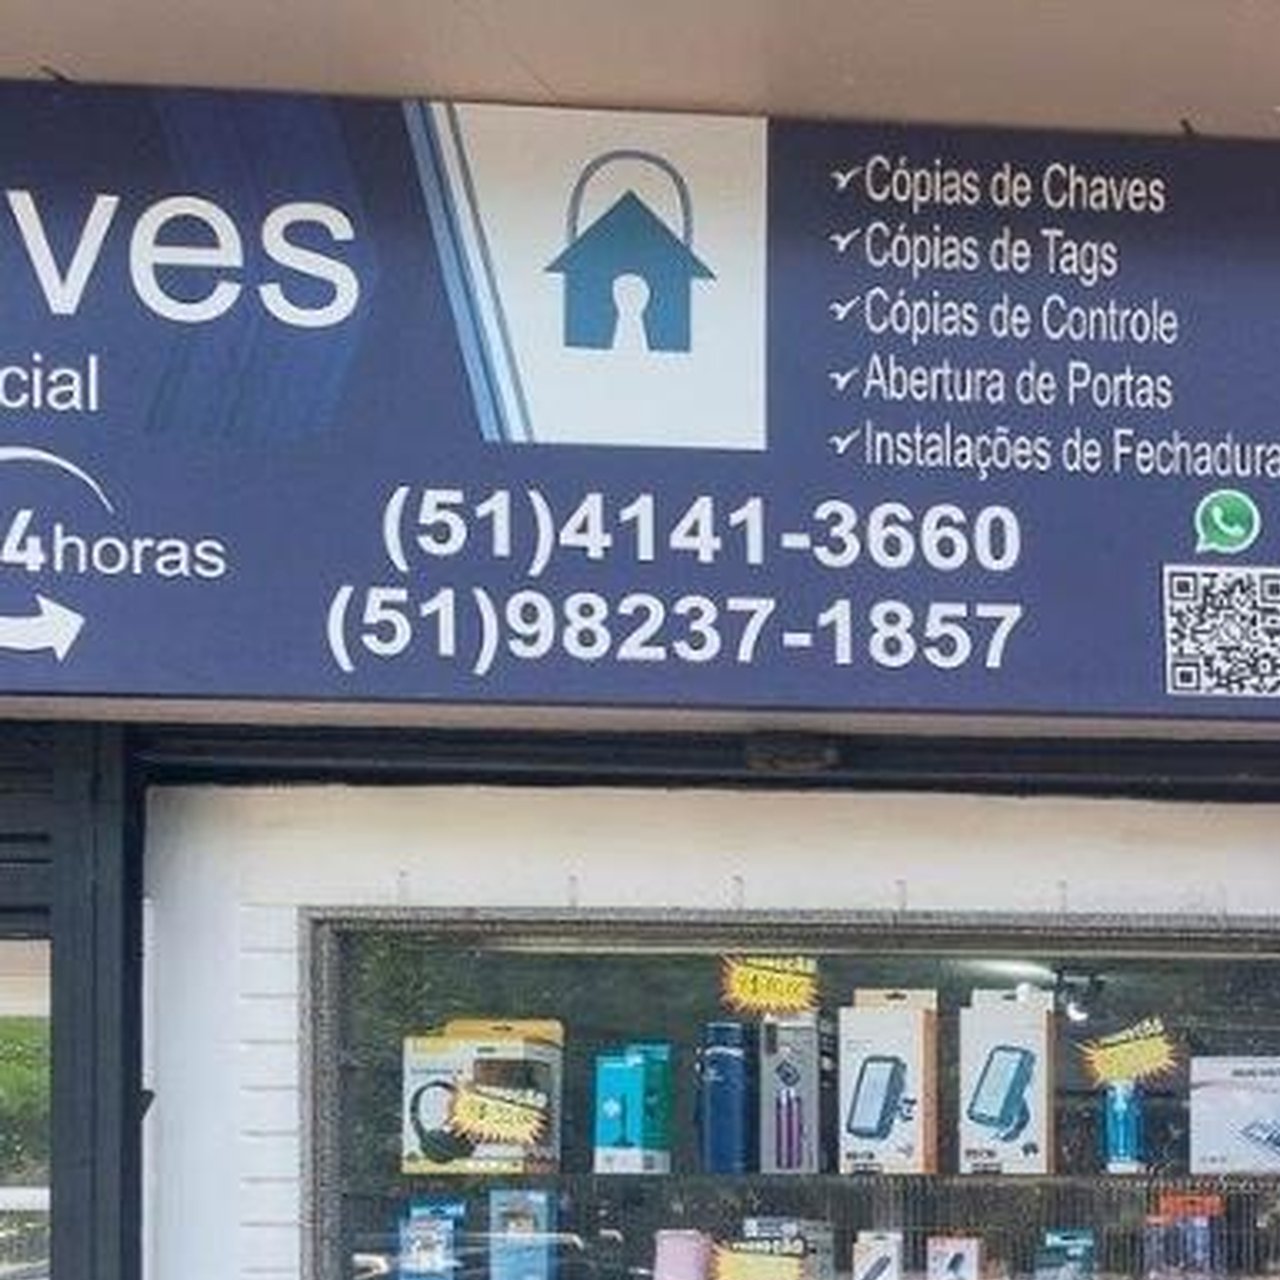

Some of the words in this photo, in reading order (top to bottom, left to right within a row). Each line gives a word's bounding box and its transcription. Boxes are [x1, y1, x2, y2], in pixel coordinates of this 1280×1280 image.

[865, 154, 981, 215] Cópias
[990, 162, 1032, 208] de
[1042, 162, 1166, 213] Chaves
[7, 190, 360, 328] ves
[865, 221, 981, 281] Cópias
[989, 227, 1032, 274] de
[1040, 228, 1118, 288] Tags
[864, 286, 980, 346] Cópias
[989, 293, 1031, 339] de
[1042, 293, 1179, 345] Controle
[0, 352, 98, 411] cial
[862, 352, 1005, 405] Abertura
[1015, 359, 1057, 405] de
[1068, 360, 1173, 410] Portas
[865, 419, 1052, 481] Instalações
[1061, 426, 1102, 473] de
[383, 486, 1021, 577] (51)4141-3660
[327, 585, 1022, 676] (51)98237-1857
